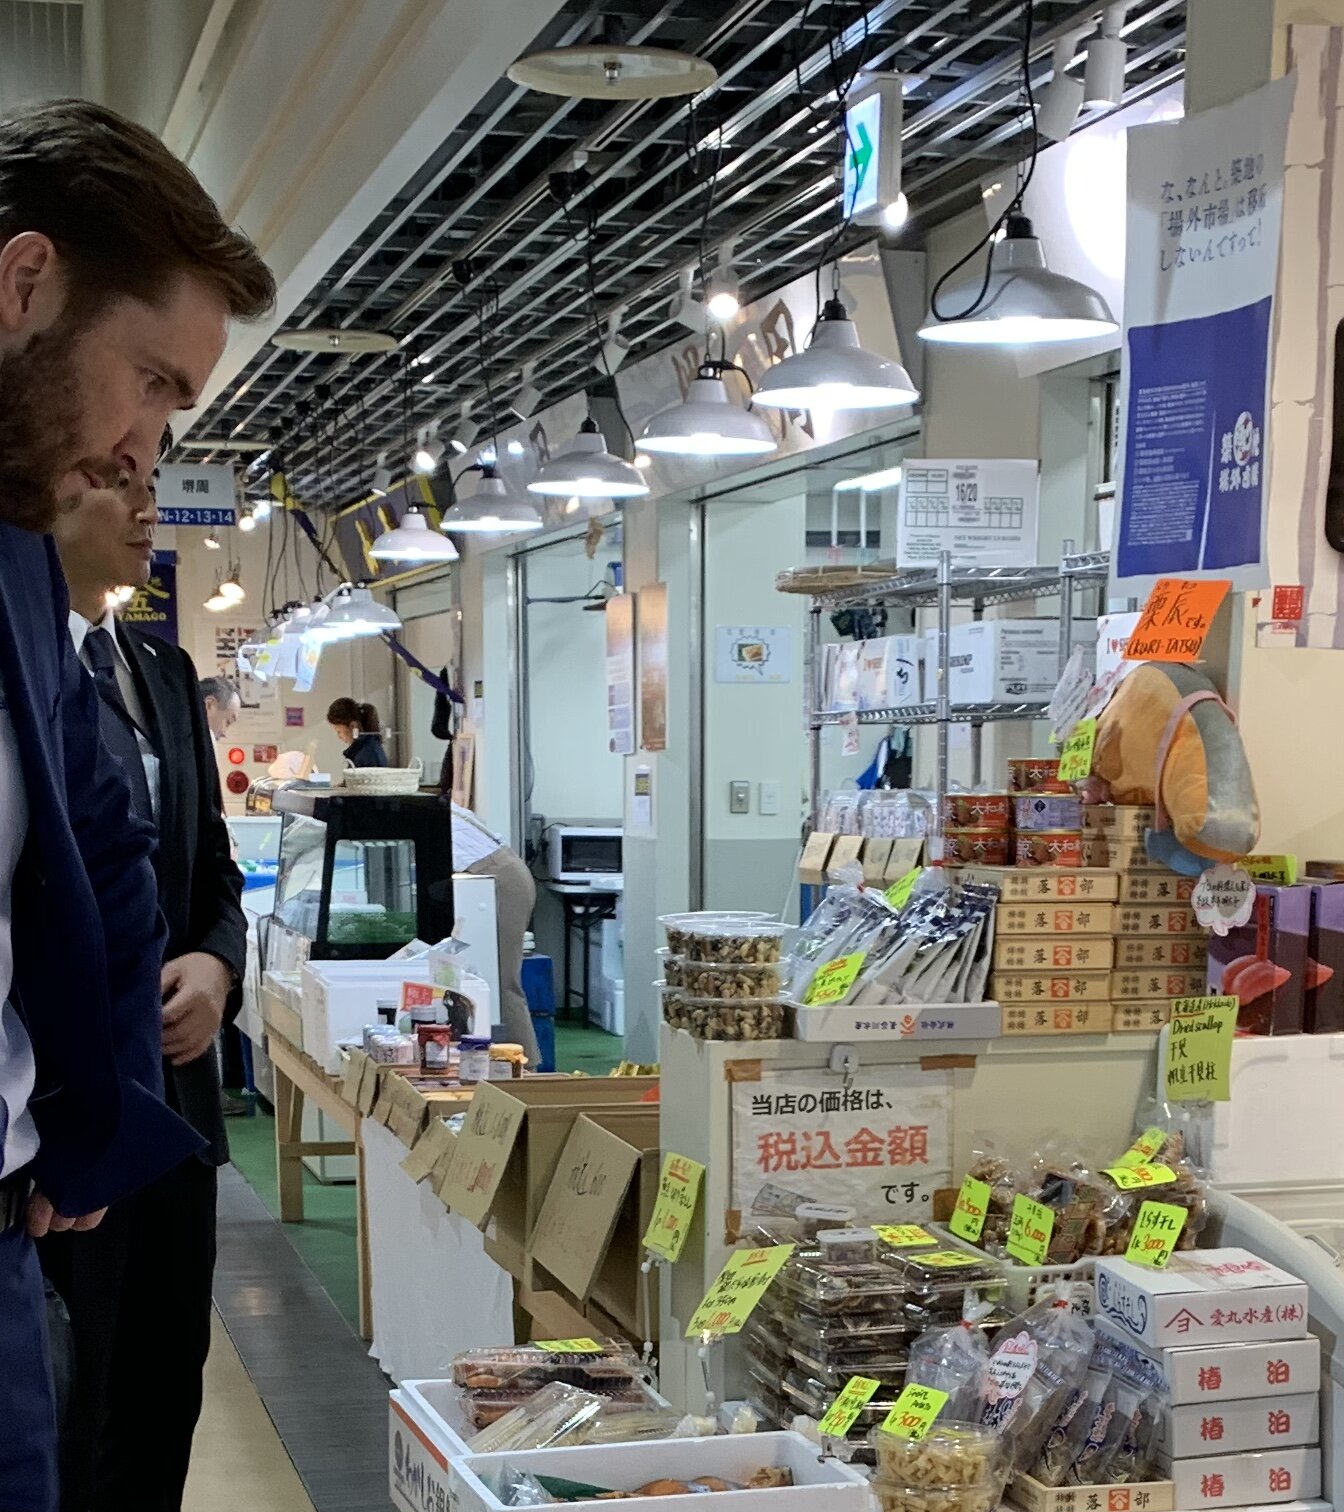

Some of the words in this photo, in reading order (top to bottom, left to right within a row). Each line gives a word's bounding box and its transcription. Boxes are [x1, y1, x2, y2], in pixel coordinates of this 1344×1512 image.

[752, 1089, 894, 1116] 当店の価格は、
[757, 1125, 929, 1173] 税込金額
[881, 1182, 929, 1204] です。
